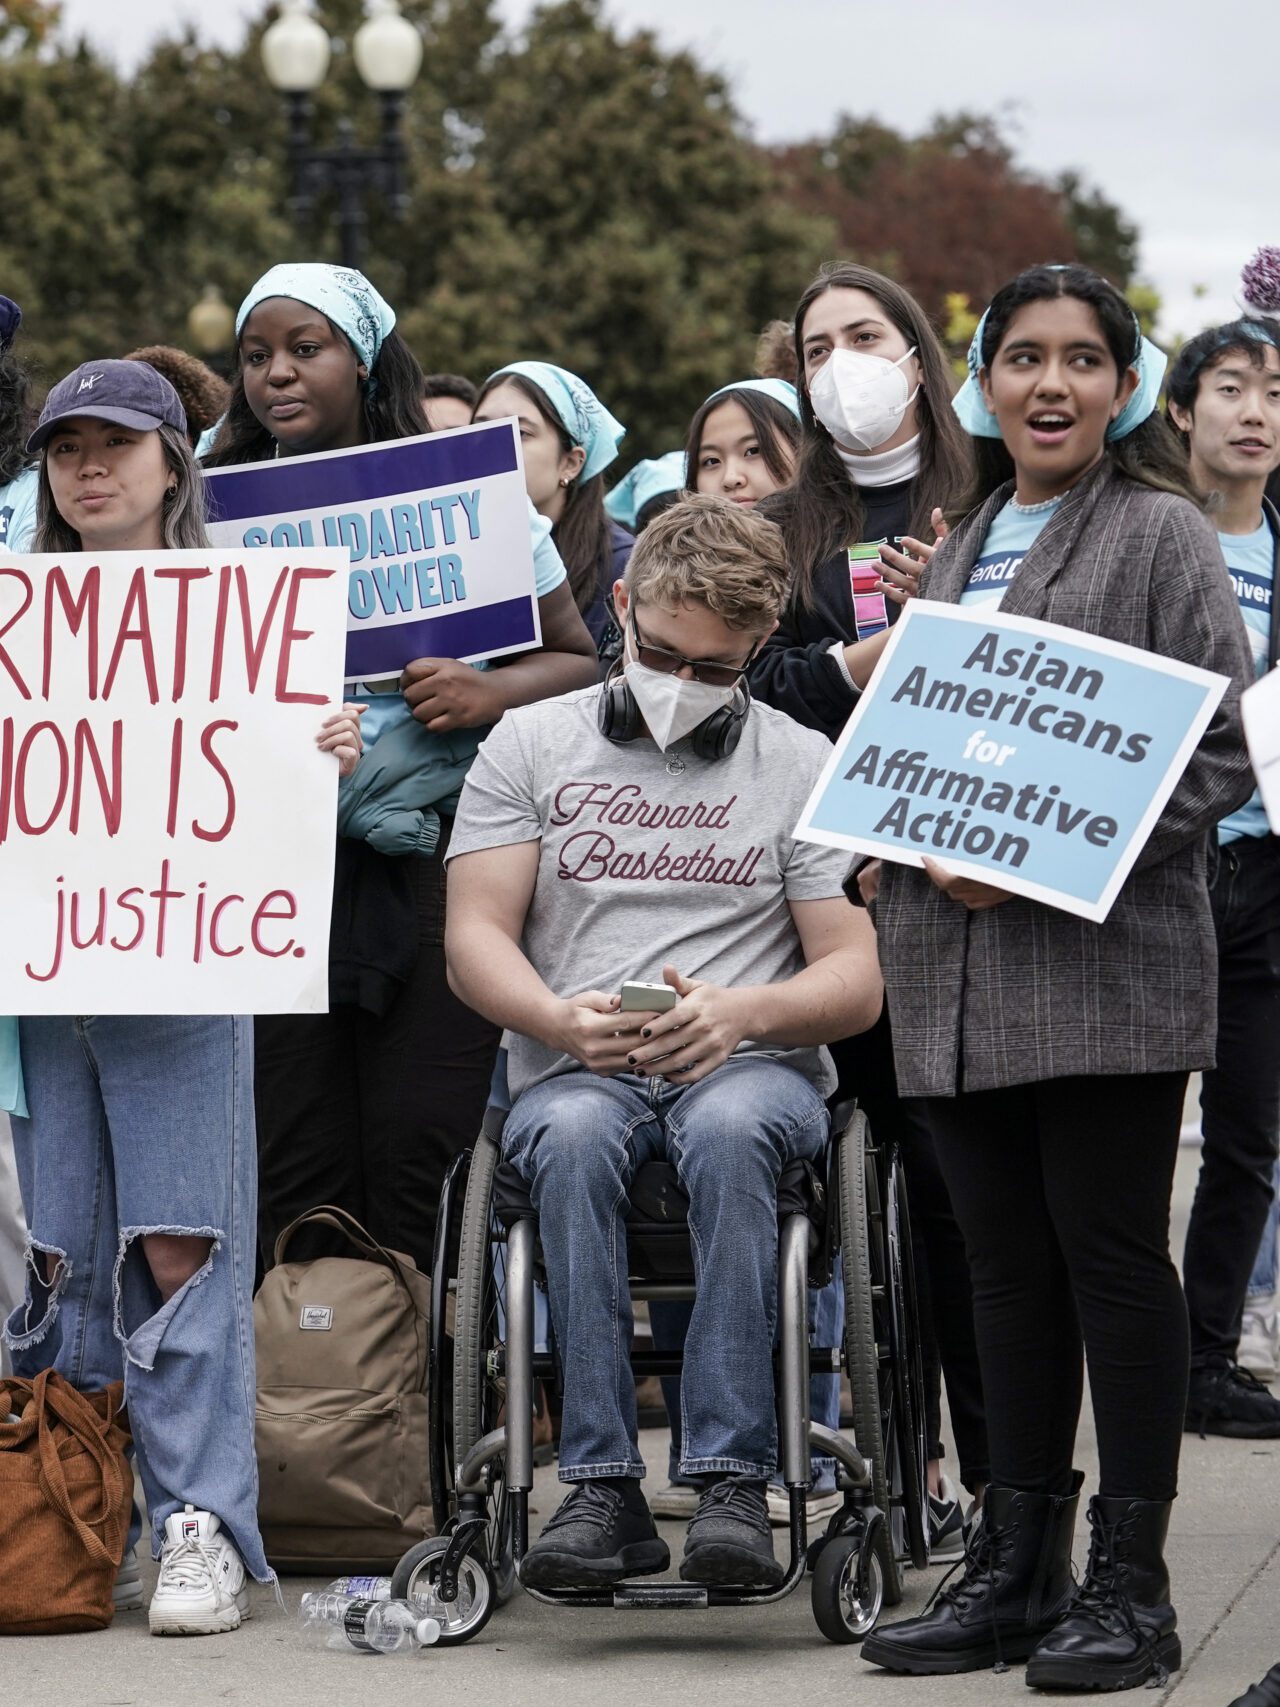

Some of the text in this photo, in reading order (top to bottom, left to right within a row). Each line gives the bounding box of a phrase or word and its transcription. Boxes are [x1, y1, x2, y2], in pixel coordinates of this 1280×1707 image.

[348, 553, 467, 620] OWER
[961, 631, 1105, 701] Asian
[890, 665, 1154, 765] Americans
[962, 730, 1017, 768] for
[166, 717, 239, 843] IS
[549, 782, 738, 831] Harvard
[843, 744, 1119, 849] Affirmative
[557, 829, 765, 888] Basketball
[873, 796, 1030, 868] Action
[25, 858, 306, 982] justice.
